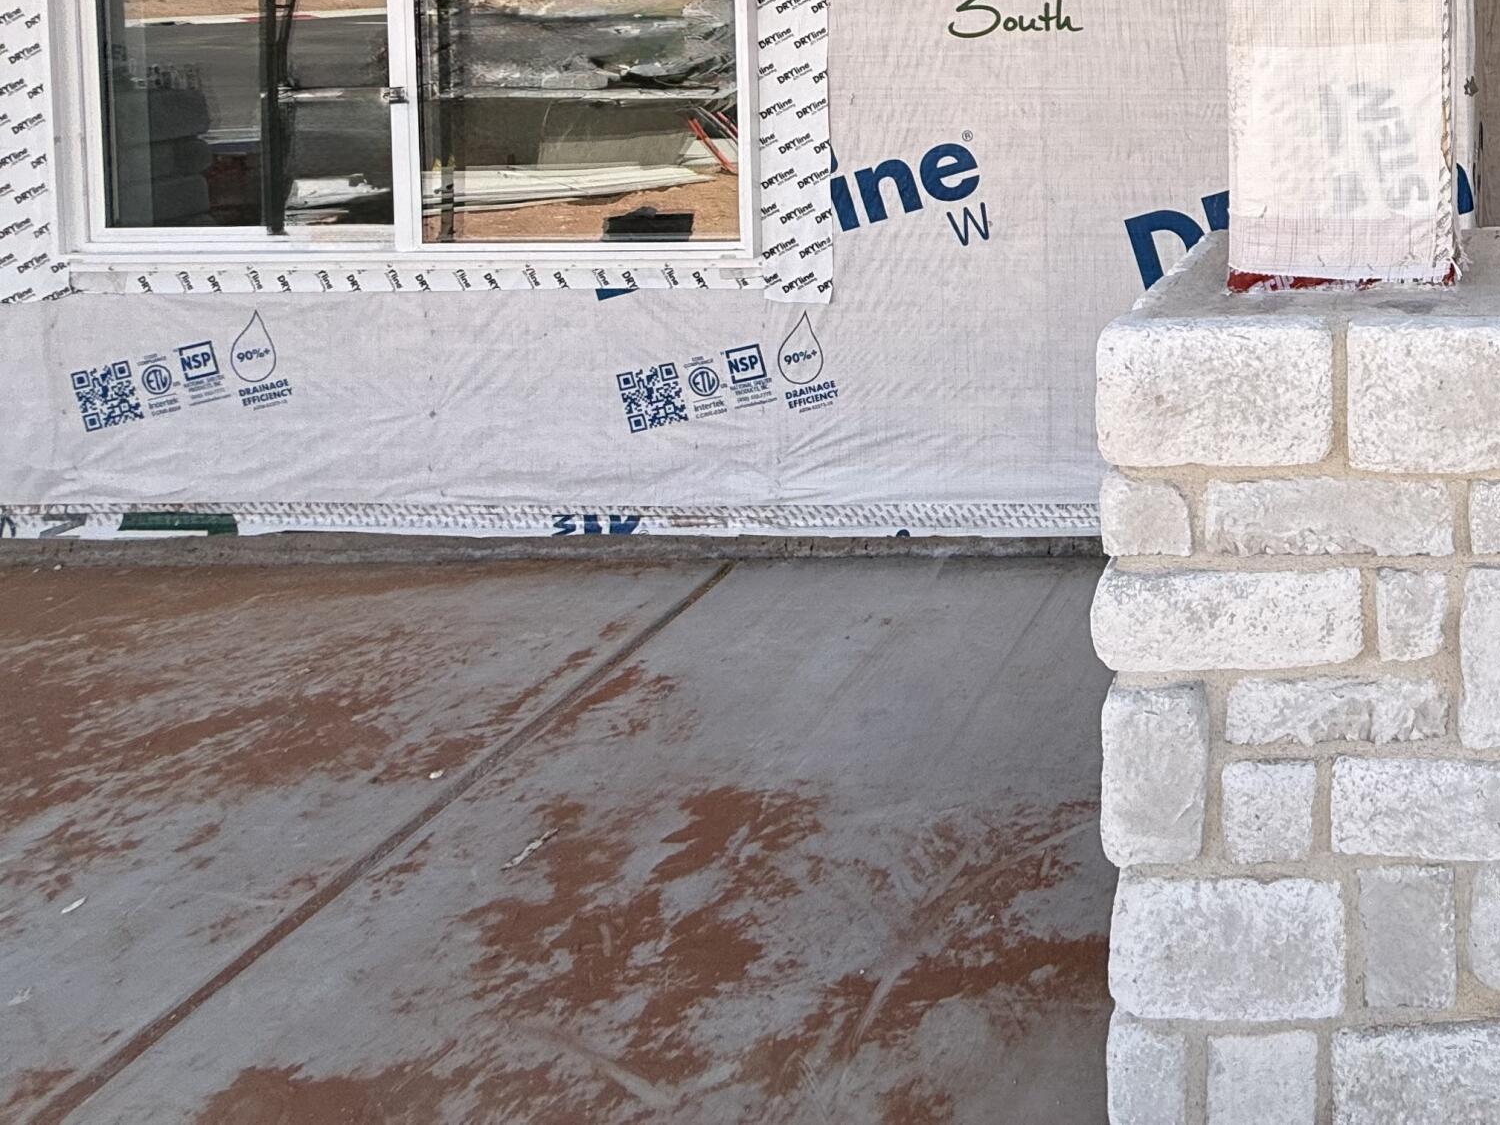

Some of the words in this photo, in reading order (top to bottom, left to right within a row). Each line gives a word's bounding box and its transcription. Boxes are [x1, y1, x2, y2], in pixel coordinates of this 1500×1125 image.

[180, 352, 211, 372] NSP
[727, 354, 758, 375] NSP
[784, 349, 818, 365] 90%+
[238, 379, 289, 397] DRAINAGE
[241, 387, 292, 407] EFFICIENCY
[785, 380, 836, 400] DRAINAGE
[787, 389, 839, 410] EFFICIENCY
